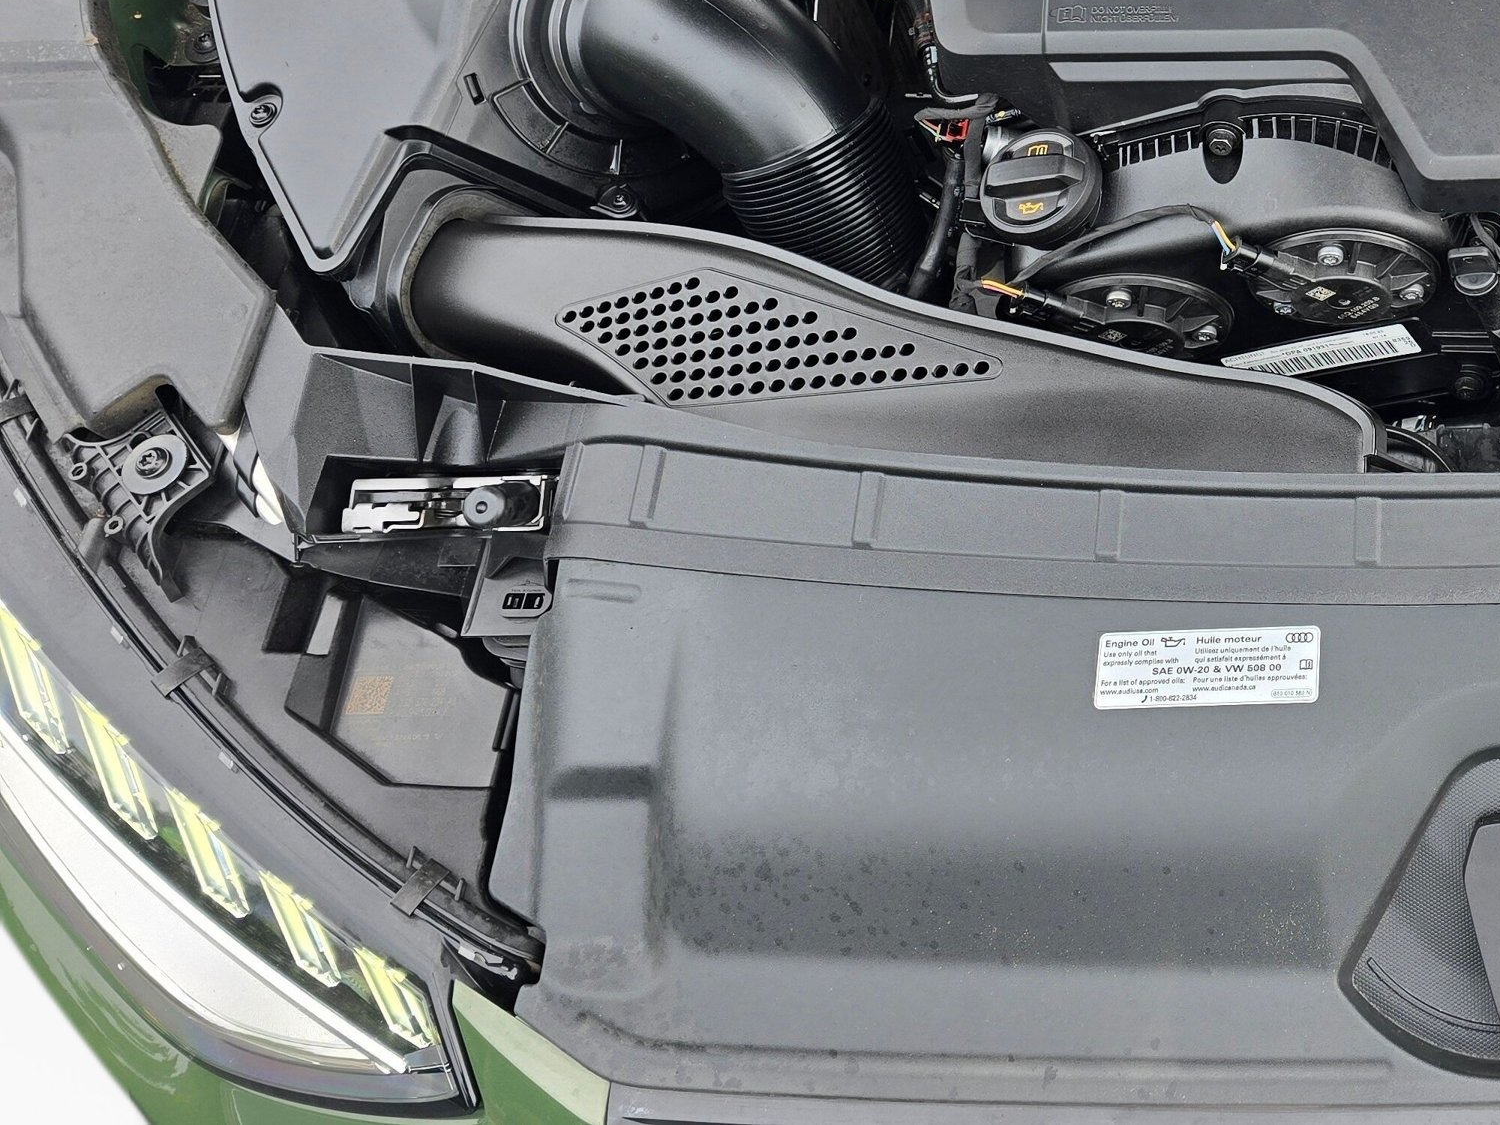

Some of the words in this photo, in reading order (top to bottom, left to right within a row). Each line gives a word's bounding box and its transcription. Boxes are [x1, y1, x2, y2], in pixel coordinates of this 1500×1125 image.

[1091, 6, 1105, 15] DO
[1106, 5, 1126, 14] NOT
[1105, 639, 1139, 649] Engine
[1141, 638, 1155, 647] Oil
[1196, 636, 1221, 644] Huile
[1224, 636, 1262, 644] moteur
[1220, 646, 1260, 654] uniquement
[1102, 659, 1134, 667] expressly
[1134, 658, 1164, 666] complies
[1194, 656, 1206, 664] qui
[1206, 655, 1233, 663] satisfait
[1152, 666, 1174, 676] SAE
[1176, 665, 1210, 674] 0W-20
[1213, 665, 1222, 673] &
[1225, 664, 1244, 673] VW
[1246, 663, 1266, 672] 508
[1269, 663, 1282, 671] 00
[1138, 677, 1170, 686] approved
[1100, 687, 1159, 696] www.audiusa.com
[1192, 684, 1256, 692] www.audicanada.ca
[1150, 694, 1197, 702] 1-800-822-2834
